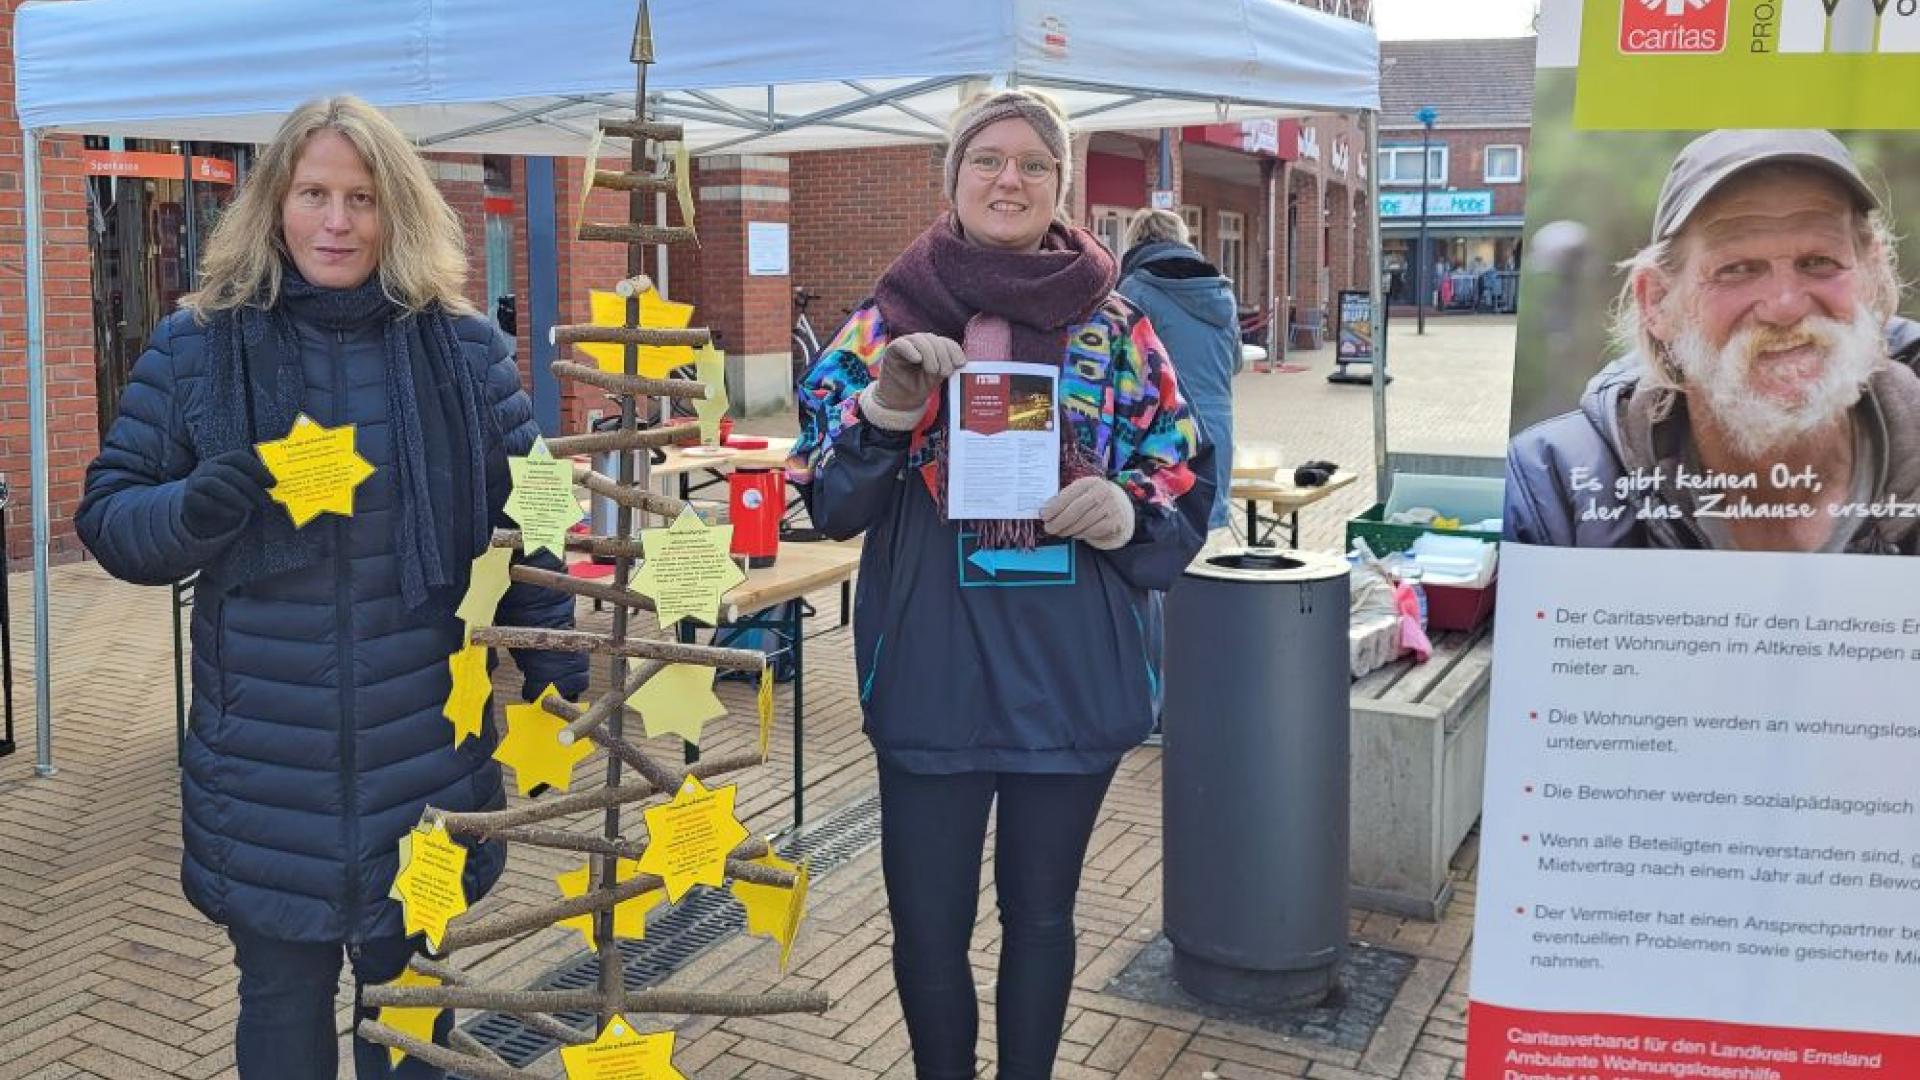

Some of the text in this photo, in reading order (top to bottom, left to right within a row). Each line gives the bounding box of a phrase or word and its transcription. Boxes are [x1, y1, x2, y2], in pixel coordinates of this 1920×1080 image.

[1629, 24, 1716, 49] caritas
[1751, 0, 1775, 53] PRO
[1570, 463, 1822, 498] Es gibt keinen Ort,
[1581, 498, 1626, 521] der
[1636, 498, 1682, 520] das
[1693, 494, 1817, 520] Zuhause
[1556, 608, 1587, 625] Der
[1593, 609, 1728, 629] Caritasverband
[1735, 612, 1759, 630] für
[1764, 614, 1799, 631] den
[1806, 615, 1895, 634] Landkreis
[1553, 635, 1608, 651] mietet
[1615, 635, 1720, 656] Wohnungen
[1727, 639, 1748, 655] im
[1754, 640, 1822, 658] Altkreis
[1828, 642, 1904, 662] Meppen
[1552, 660, 1640, 677] mieter an.
[1548, 708, 1578, 725] Die
[1583, 710, 1688, 731] Wohnungen
[1694, 713, 1760, 732] werden
[1766, 719, 1788, 733] an
[1547, 736, 1677, 753] untervermietet.
[1543, 783, 1913, 816] Die Bewohner werden sozialpädagogisch
[1539, 832, 1588, 849] Wenn
[1594, 834, 1623, 850] alle
[1628, 835, 1722, 856] Beteiligten
[1728, 842, 1856, 862] einverstanden
[1538, 856, 1635, 877] Mietvertrag
[1641, 861, 1684, 878] nach
[1690, 864, 1744, 881] einem
[1750, 866, 1790, 884] Jahr
[1795, 869, 1824, 885] auf
[1829, 871, 1863, 887] den
[1535, 904, 1565, 920] Der
[1571, 906, 1652, 924] Vermieter
[1657, 909, 1685, 925] hat
[1690, 912, 1738, 929] einen
[1743, 914, 1896, 940] Ansprechpartner
[1530, 953, 1604, 970] nahmen.
[1533, 930, 1629, 946] eventuellen
[1636, 932, 1731, 952] Problemen
[1737, 940, 1790, 958] sowie
[1795, 942, 1888, 965] gesicherte
[1506, 1027, 1882, 1069] Caritasverband für den Landkreis Emsland
[1505, 1048, 1599, 1068] Ambulante
[1603, 1054, 1782, 1080] Wohnungslosenhilfe
